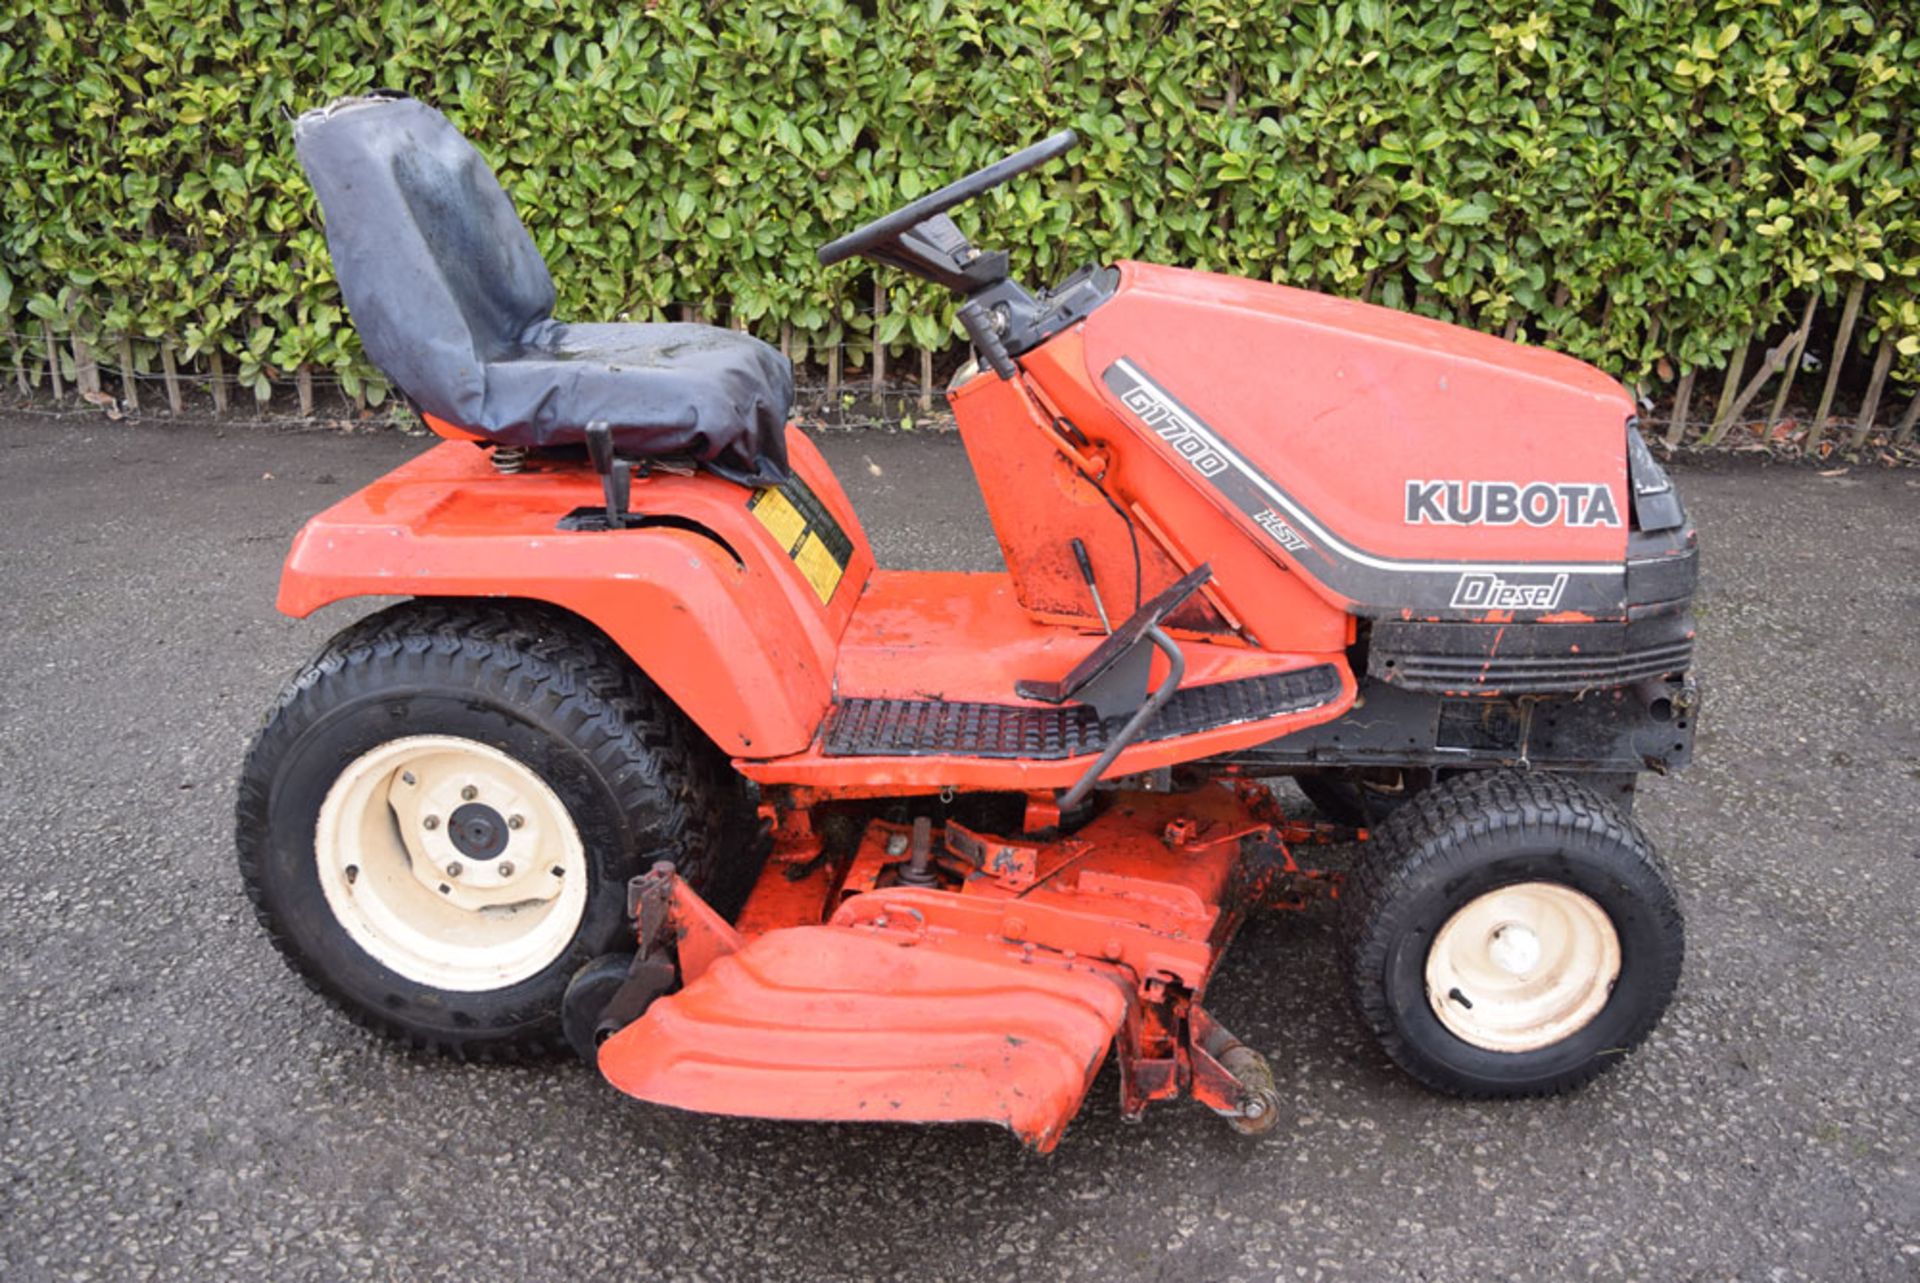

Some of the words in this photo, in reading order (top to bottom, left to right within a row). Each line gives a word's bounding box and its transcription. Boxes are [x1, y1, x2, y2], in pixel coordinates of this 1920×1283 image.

[1121, 386, 1228, 477] G1700
[1405, 480, 1622, 528] KUBOTA
[1253, 509, 1308, 551] HST
[1450, 572, 1569, 609] Diesel
